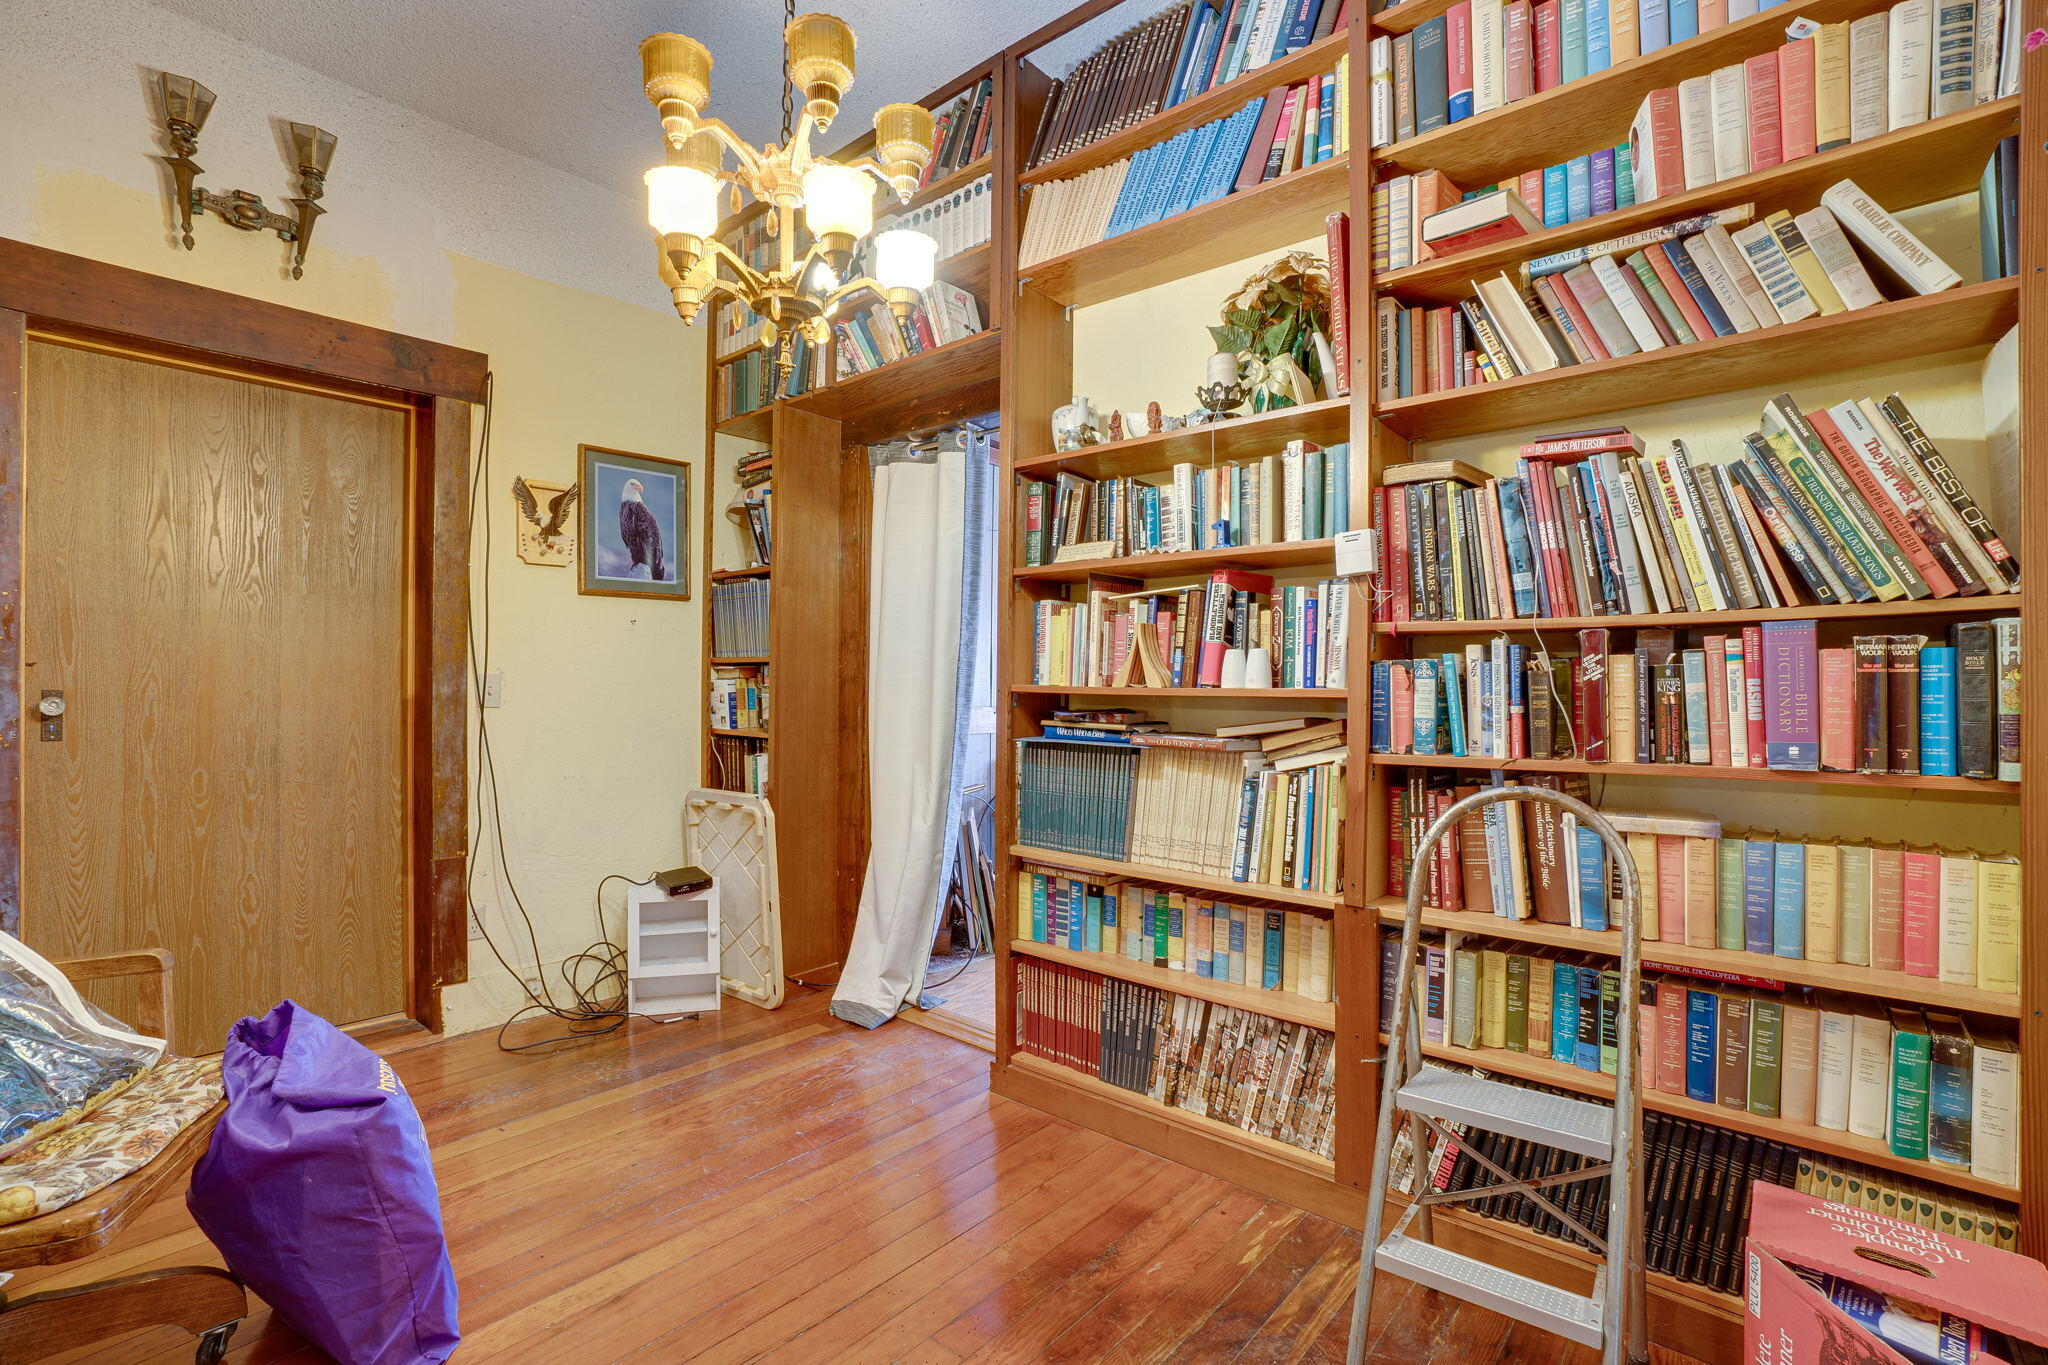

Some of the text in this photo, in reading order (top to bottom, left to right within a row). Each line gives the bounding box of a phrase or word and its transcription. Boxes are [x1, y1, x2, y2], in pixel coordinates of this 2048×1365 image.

[1419, 29, 1440, 42] COLLEGE
[1398, 43, 1408, 118] FIRESIDE READER
[1217, 161, 1230, 186] HISTORY
[1225, 157, 1239, 183] HISTORY
[1529, 226, 1675, 270] NEW ATLAS OF THE BIBLE
[1852, 197, 1932, 269] CHARLIE COMPANY
[1704, 259, 1735, 306] THE VIXENS
[1330, 247, 1346, 390] GREAT WORLD ATLAS
[1476, 319, 1500, 355] CITIZEN
[1784, 406, 1810, 438] ROBERGE
[1545, 438, 1606, 454] JAMES PATTERSON
[1656, 459, 1684, 520] RED RIVER
[1829, 431, 1922, 555] THE GOLDEN GEOGRAPHIC ENCYCLOPEDIA
[1864, 437, 1920, 507] The Way West
[1899, 415, 1934, 457] THE
[1925, 455, 1972, 505] BEST
[1961, 505, 1993, 533] OF
[1899, 455, 1920, 484] PACIFIC
[1917, 481, 1937, 502] COAST
[1393, 493, 1401, 535] JOURNEY
[1408, 489, 1419, 533] JOURNEY
[1623, 481, 1642, 518] ALASKA
[1688, 480, 1708, 529] Wilderness
[1755, 472, 1792, 516] THIS WAS
[1816, 451, 1887, 541] TIMBER COUNTRY
[1538, 521, 1548, 550] WINGS
[1546, 520, 1556, 549] WINGS
[1703, 478, 1753, 599] EAT BETTER LIVE BETTER
[1764, 507, 1804, 562] Our Universe
[1768, 456, 1859, 579] OUR AMAZING WORLD OF NATURE
[1806, 477, 1833, 511] TREASURY
[1833, 512, 1851, 535] BEST
[1844, 529, 1866, 558] LOVED
[1862, 554, 1886, 581] SONGS
[1425, 528, 1434, 562] INDIAN
[1579, 519, 1594, 577] Combat Photographer
[1985, 539, 2008, 561] LIFE
[1427, 564, 1435, 591] WARS
[1893, 556, 1917, 584] CAXTON
[1209, 584, 1219, 641] BLOODLETTERS
[1214, 593, 1225, 641] AND BADMEN
[1335, 587, 1344, 611] OLIVER
[1471, 656, 1479, 678] JESUS
[1586, 665, 1600, 675] LITTLE
[1656, 684, 1681, 692] KING
[1747, 678, 1763, 721] RASHAD
[1778, 647, 1792, 735] DICTIONARY
[1074, 728, 1087, 737] WHO
[1795, 693, 1808, 734] BIBLE
[1156, 738, 1172, 746] OLD
[1173, 739, 1193, 748] WEST
[1239, 826, 1247, 840] TIDE
[1284, 795, 1297, 861] American Indian
[1499, 822, 1508, 858] ROCKWELL
[1535, 802, 1543, 840] ncordance
[1541, 866, 1549, 890] Bible
[1546, 823, 1555, 867] Dictionary
[1236, 840, 1246, 867] TURNING
[1502, 860, 1513, 895] ILLUSTRATOR
[1643, 960, 1740, 982] HOME MEDICAL ENCYCLOPEDIA
[1434, 1160, 1455, 1190] HITLER
[1805, 1206, 1970, 1264] Turkey Dinner
[1822, 1200, 1947, 1245] Trimmings
[1831, 1222, 1945, 1265] Complete
[1750, 1255, 1761, 1313] PLU 5400
[1940, 1316, 1966, 1365] Sheri Rose
